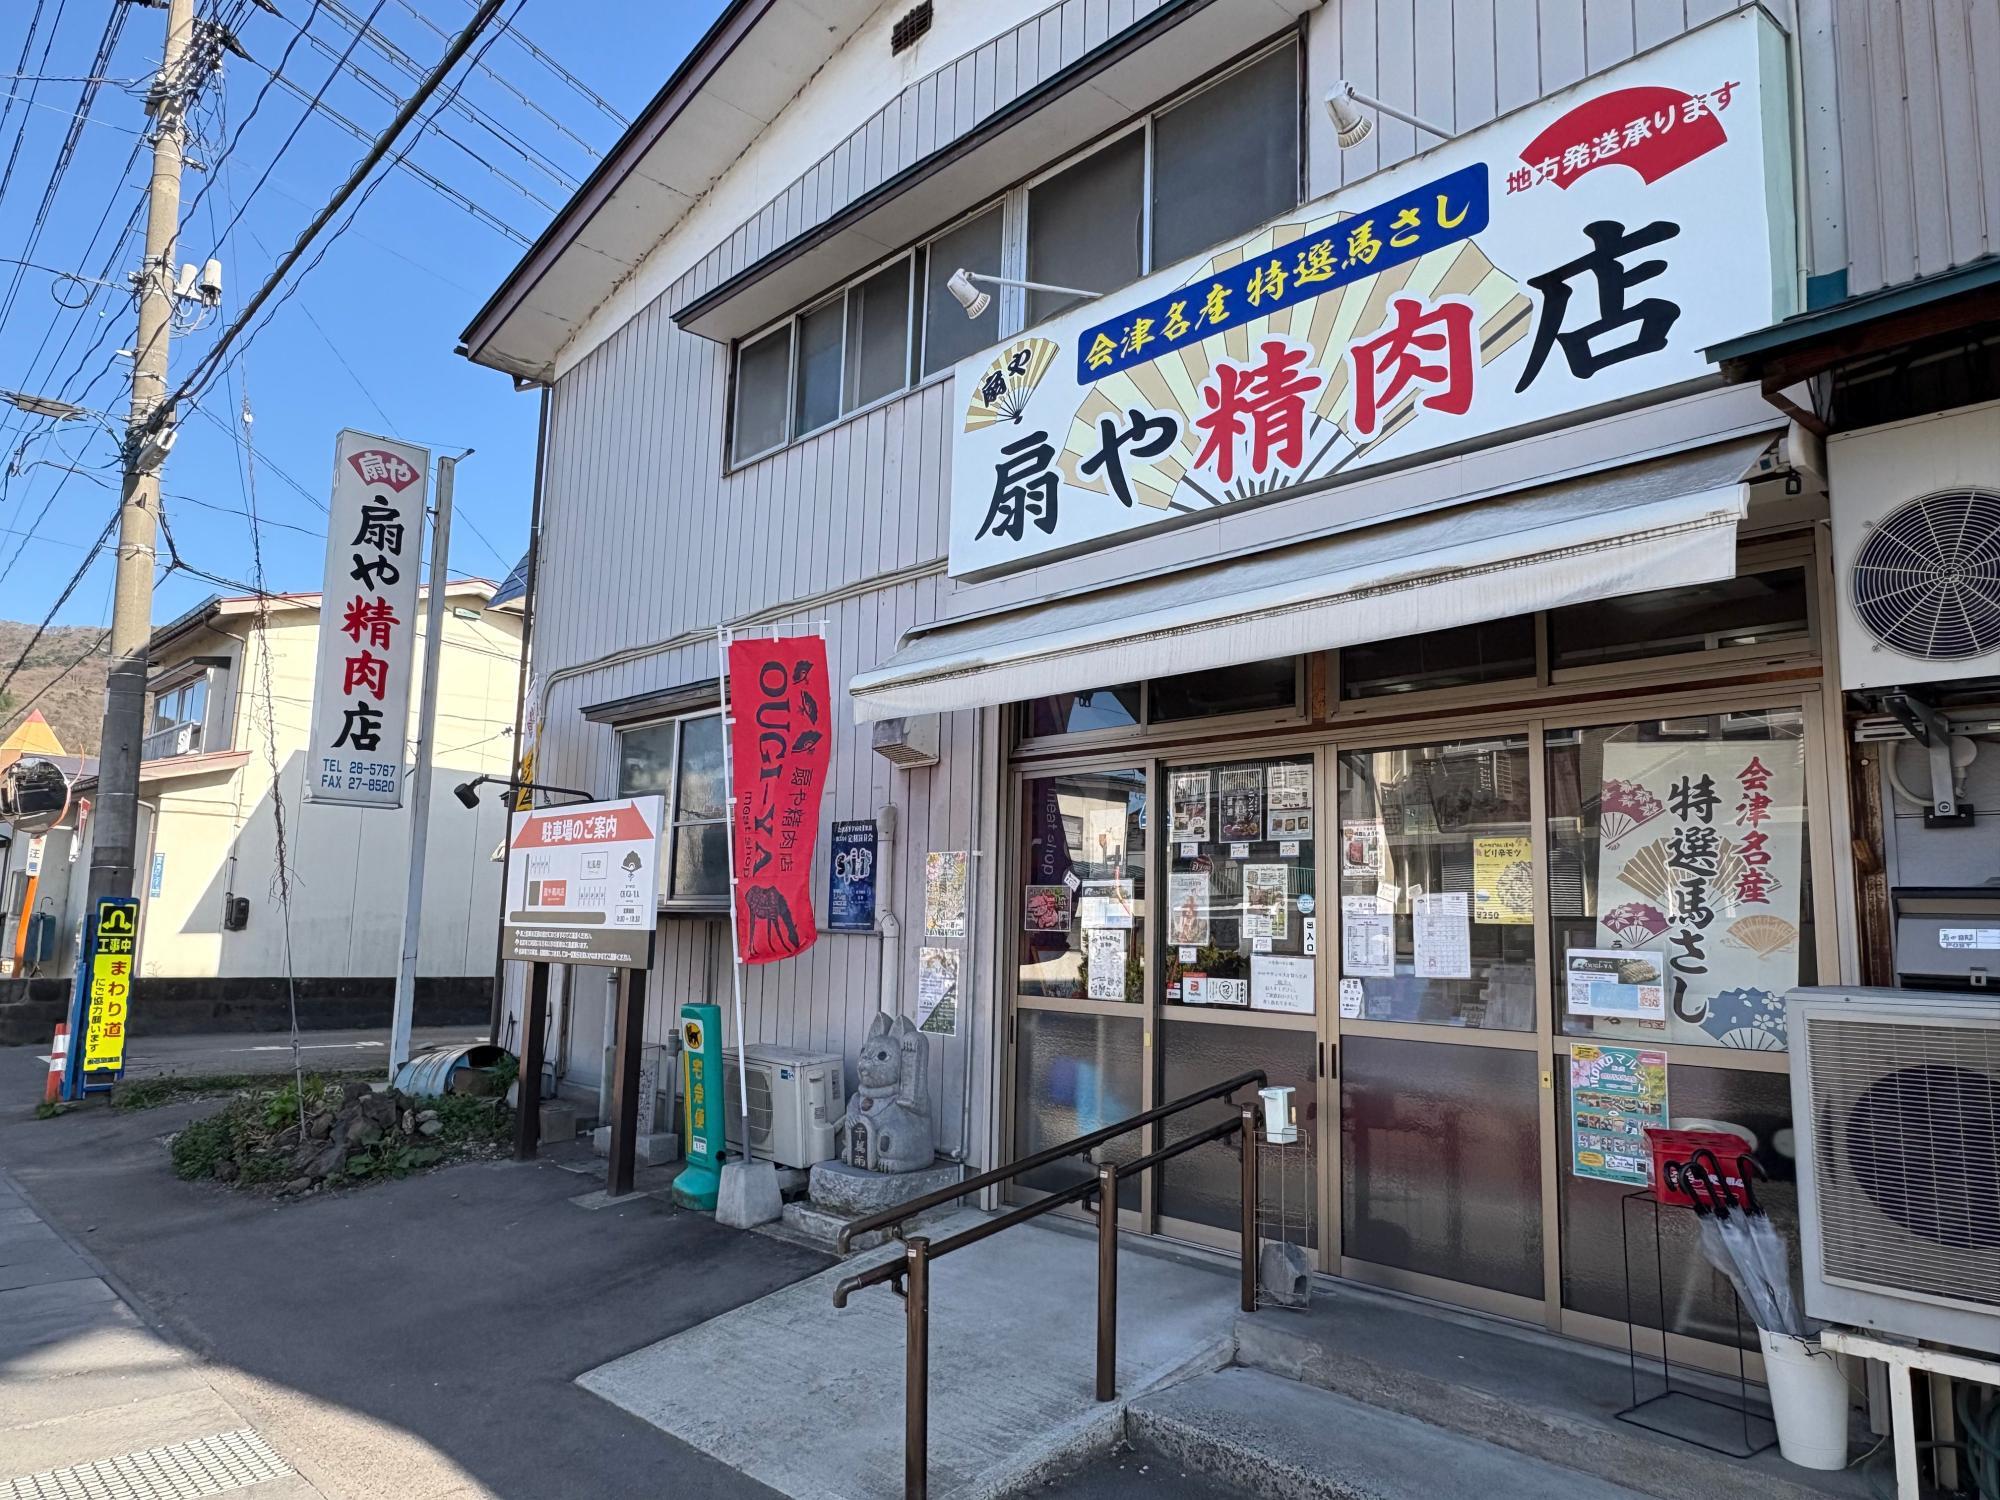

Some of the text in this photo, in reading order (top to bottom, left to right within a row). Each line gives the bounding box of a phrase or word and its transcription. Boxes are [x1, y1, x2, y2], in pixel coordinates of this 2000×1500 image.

[1506, 81, 1741, 196] 地方発送承ります
[1084, 194, 1471, 371] 会津名産 特選馬さし
[974, 219, 1682, 542] 扇や精肉店
[358, 452, 411, 484] 扇や
[330, 494, 405, 752] 扇や精肉店
[321, 774, 395, 793] FAX 27-8520
[322, 758, 396, 778] TEL 28-5767
[755, 660, 792, 878] OUGI-YA
[541, 814, 618, 843] 駐車場のご案内
[742, 836, 753, 879] shop
[779, 766, 814, 873] 扇や精肉店
[1484, 848, 1522, 858] ピリ辛モツ
[1733, 755, 1775, 906] 会津名産
[1476, 910, 1500, 920] ¥250
[1667, 773, 1722, 1025] 特選馬さし
[97, 938, 132, 953] 工事中
[90, 978, 106, 1053] にご協力願います
[103, 961, 127, 1038] まわり道
